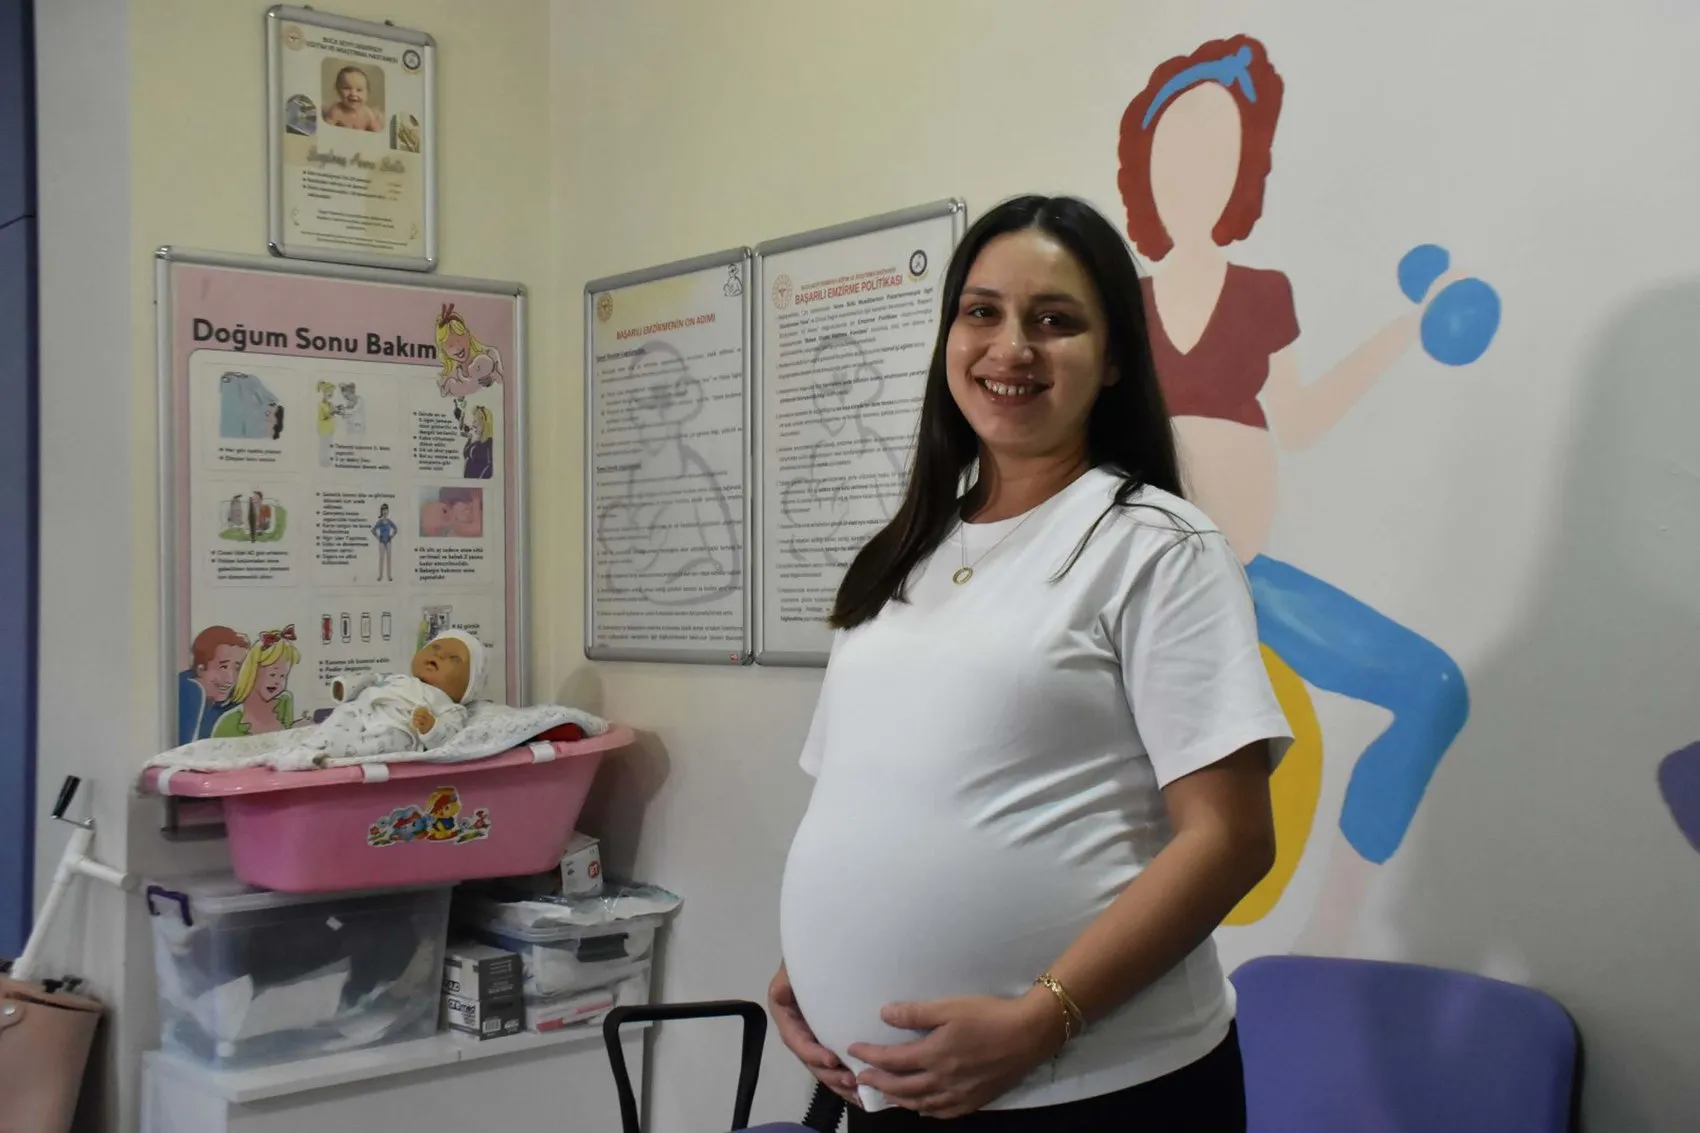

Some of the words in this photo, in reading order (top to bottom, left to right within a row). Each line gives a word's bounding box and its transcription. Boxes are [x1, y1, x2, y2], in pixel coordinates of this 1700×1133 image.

[827, 282, 860, 298] EMZİRME
[861, 274, 903, 292] POLİTİKASI
[696, 312, 716, 324] ADIMI
[192, 318, 287, 351] Doğum
[296, 327, 358, 353] Sonu
[366, 333, 437, 360] Bakım
